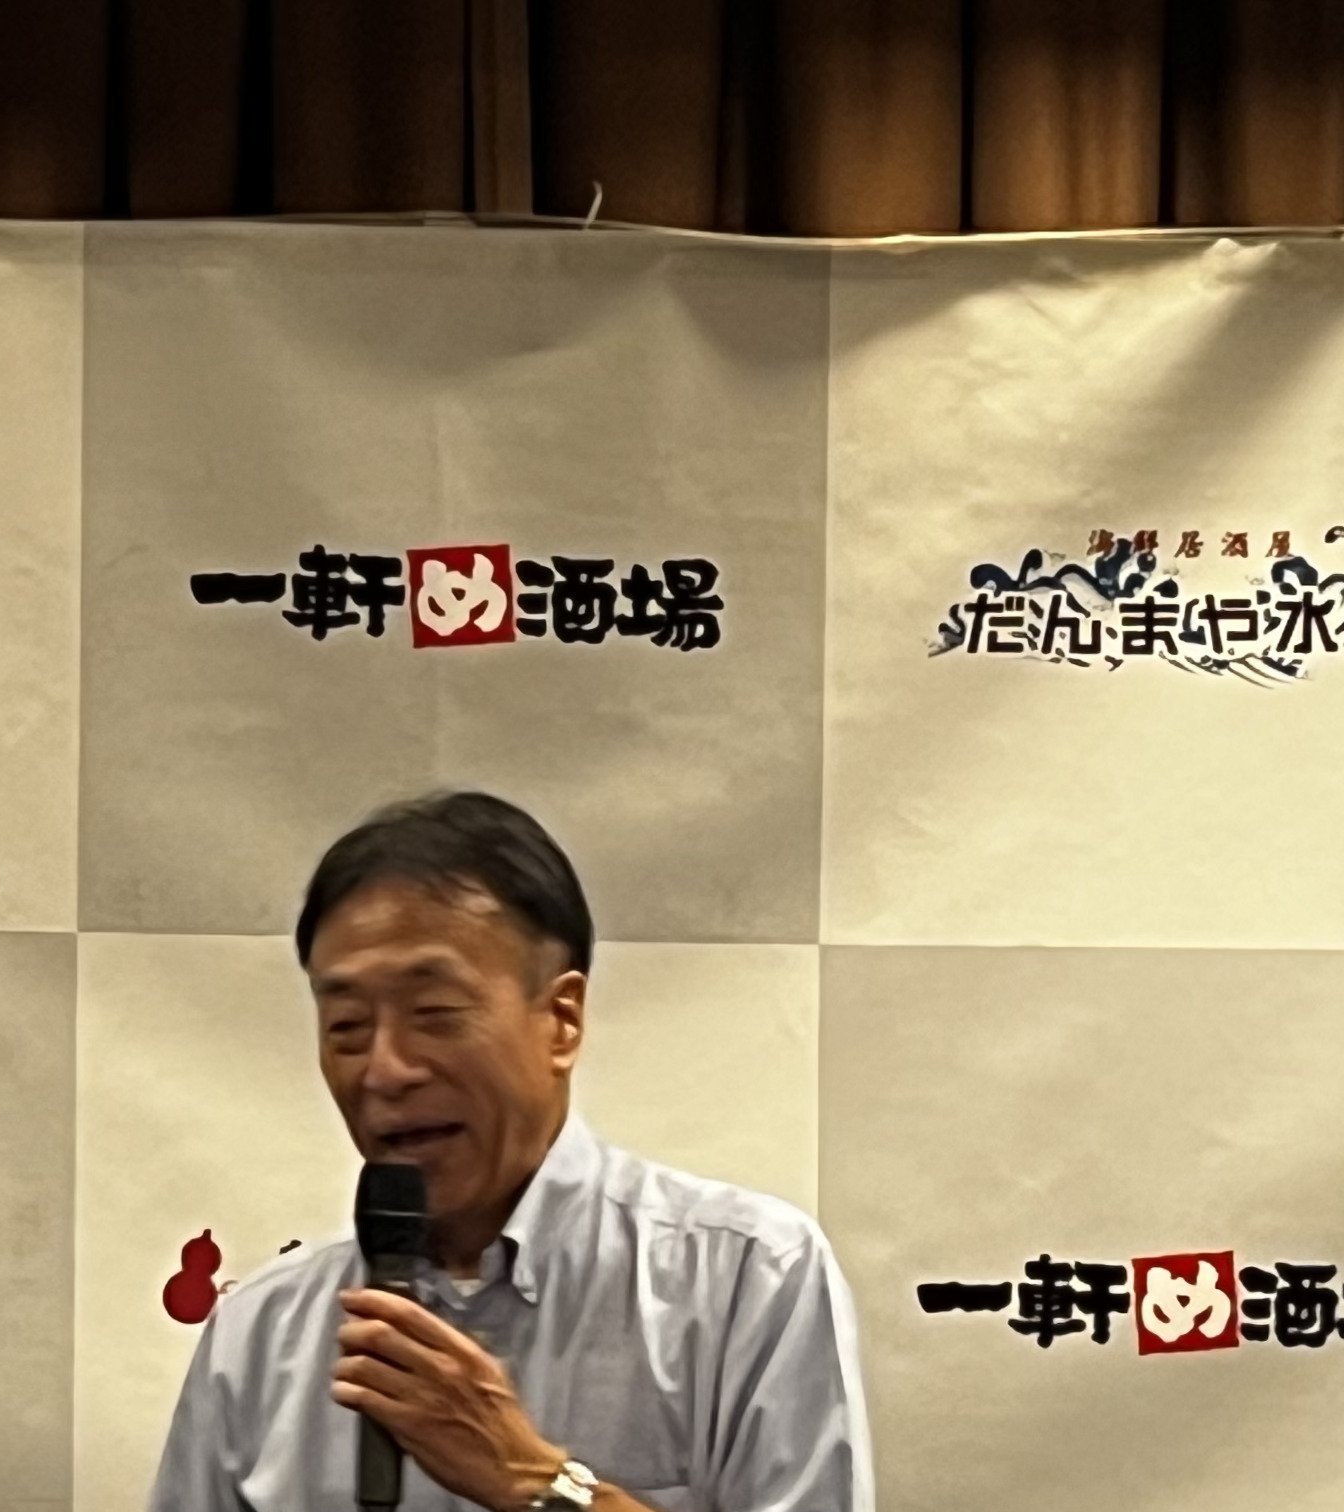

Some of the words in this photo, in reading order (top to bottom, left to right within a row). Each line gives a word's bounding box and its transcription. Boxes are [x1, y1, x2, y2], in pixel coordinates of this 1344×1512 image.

[189, 544, 724, 652] 一軒め酒場
